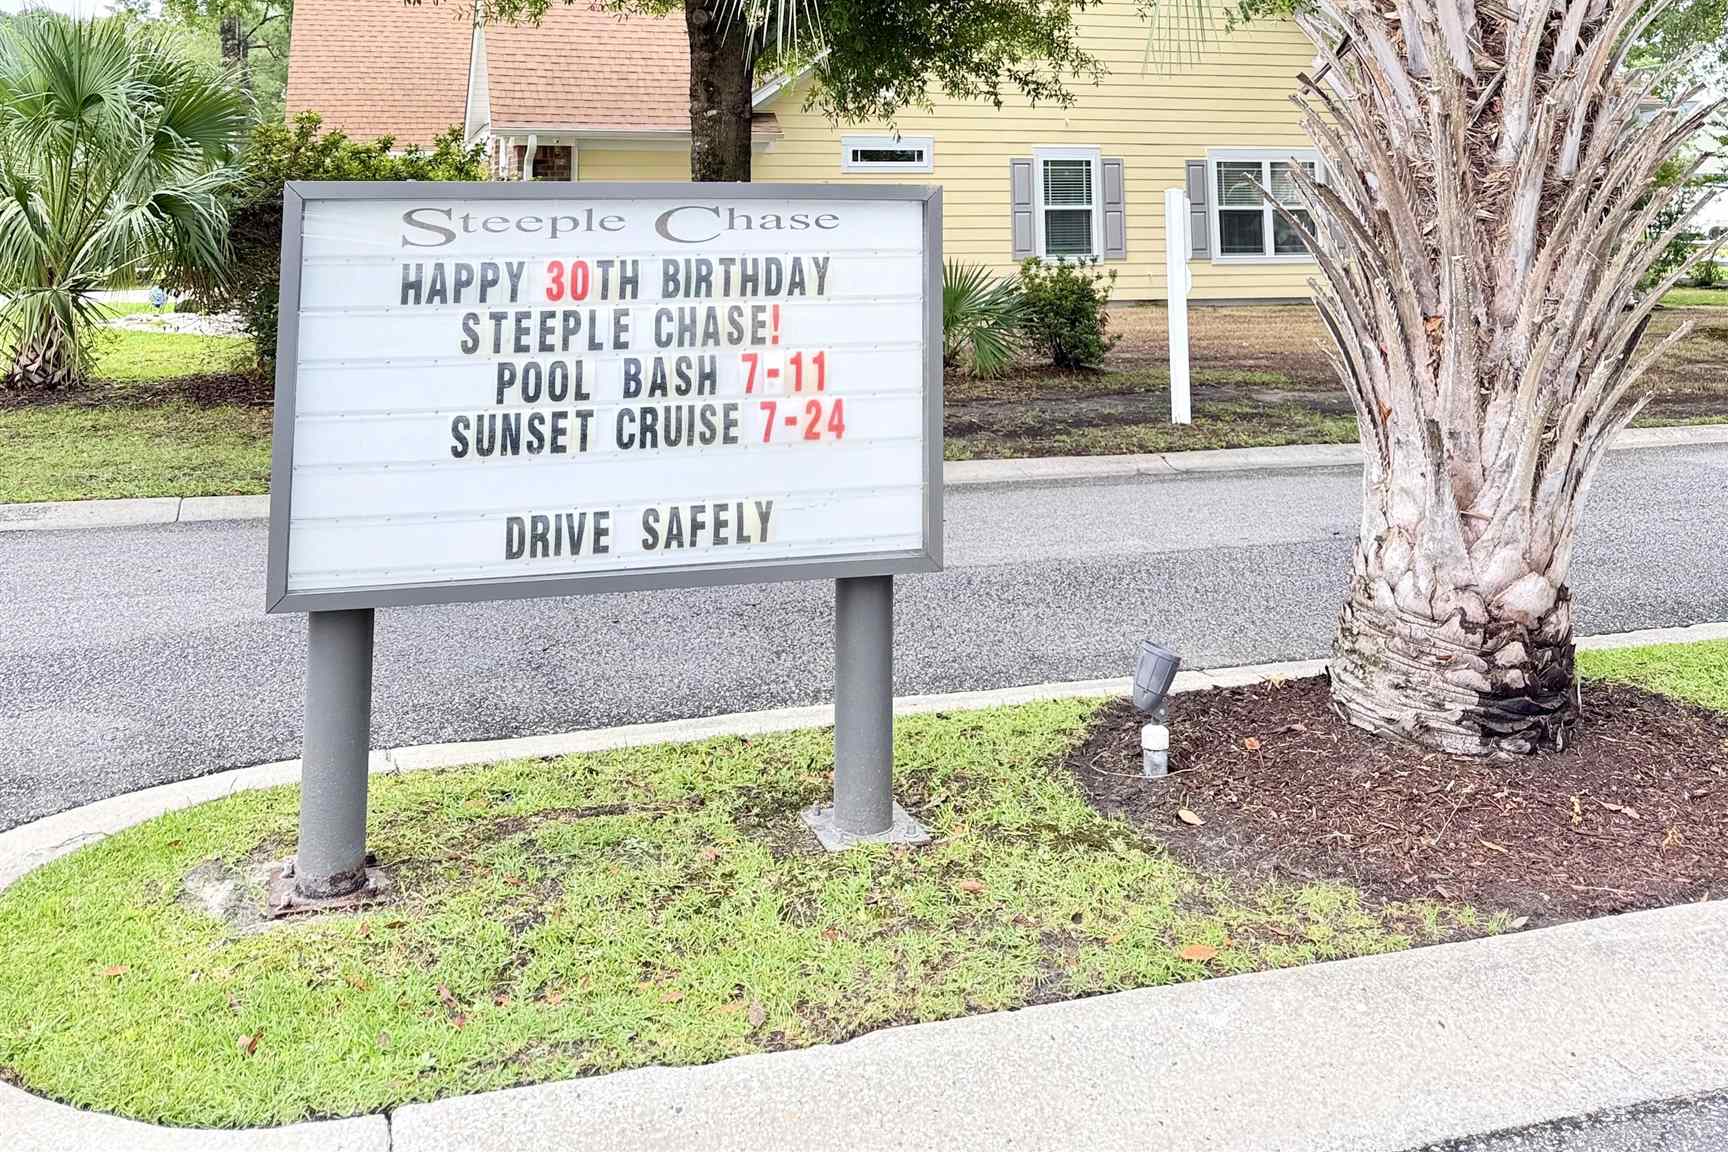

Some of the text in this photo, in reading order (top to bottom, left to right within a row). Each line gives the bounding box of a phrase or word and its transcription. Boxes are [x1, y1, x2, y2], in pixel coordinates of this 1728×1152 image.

[401, 205, 840, 248] Steeple Chase
[401, 256, 831, 305] HAPPY 30TH BIRTHDAY
[460, 304, 781, 354] STEEPLE CHASE!
[496, 351, 826, 405] POOL BASH 7-11
[450, 398, 846, 459] SUNSET CRUISE 7-24
[505, 500, 774, 561] DRIVE SAFELY
